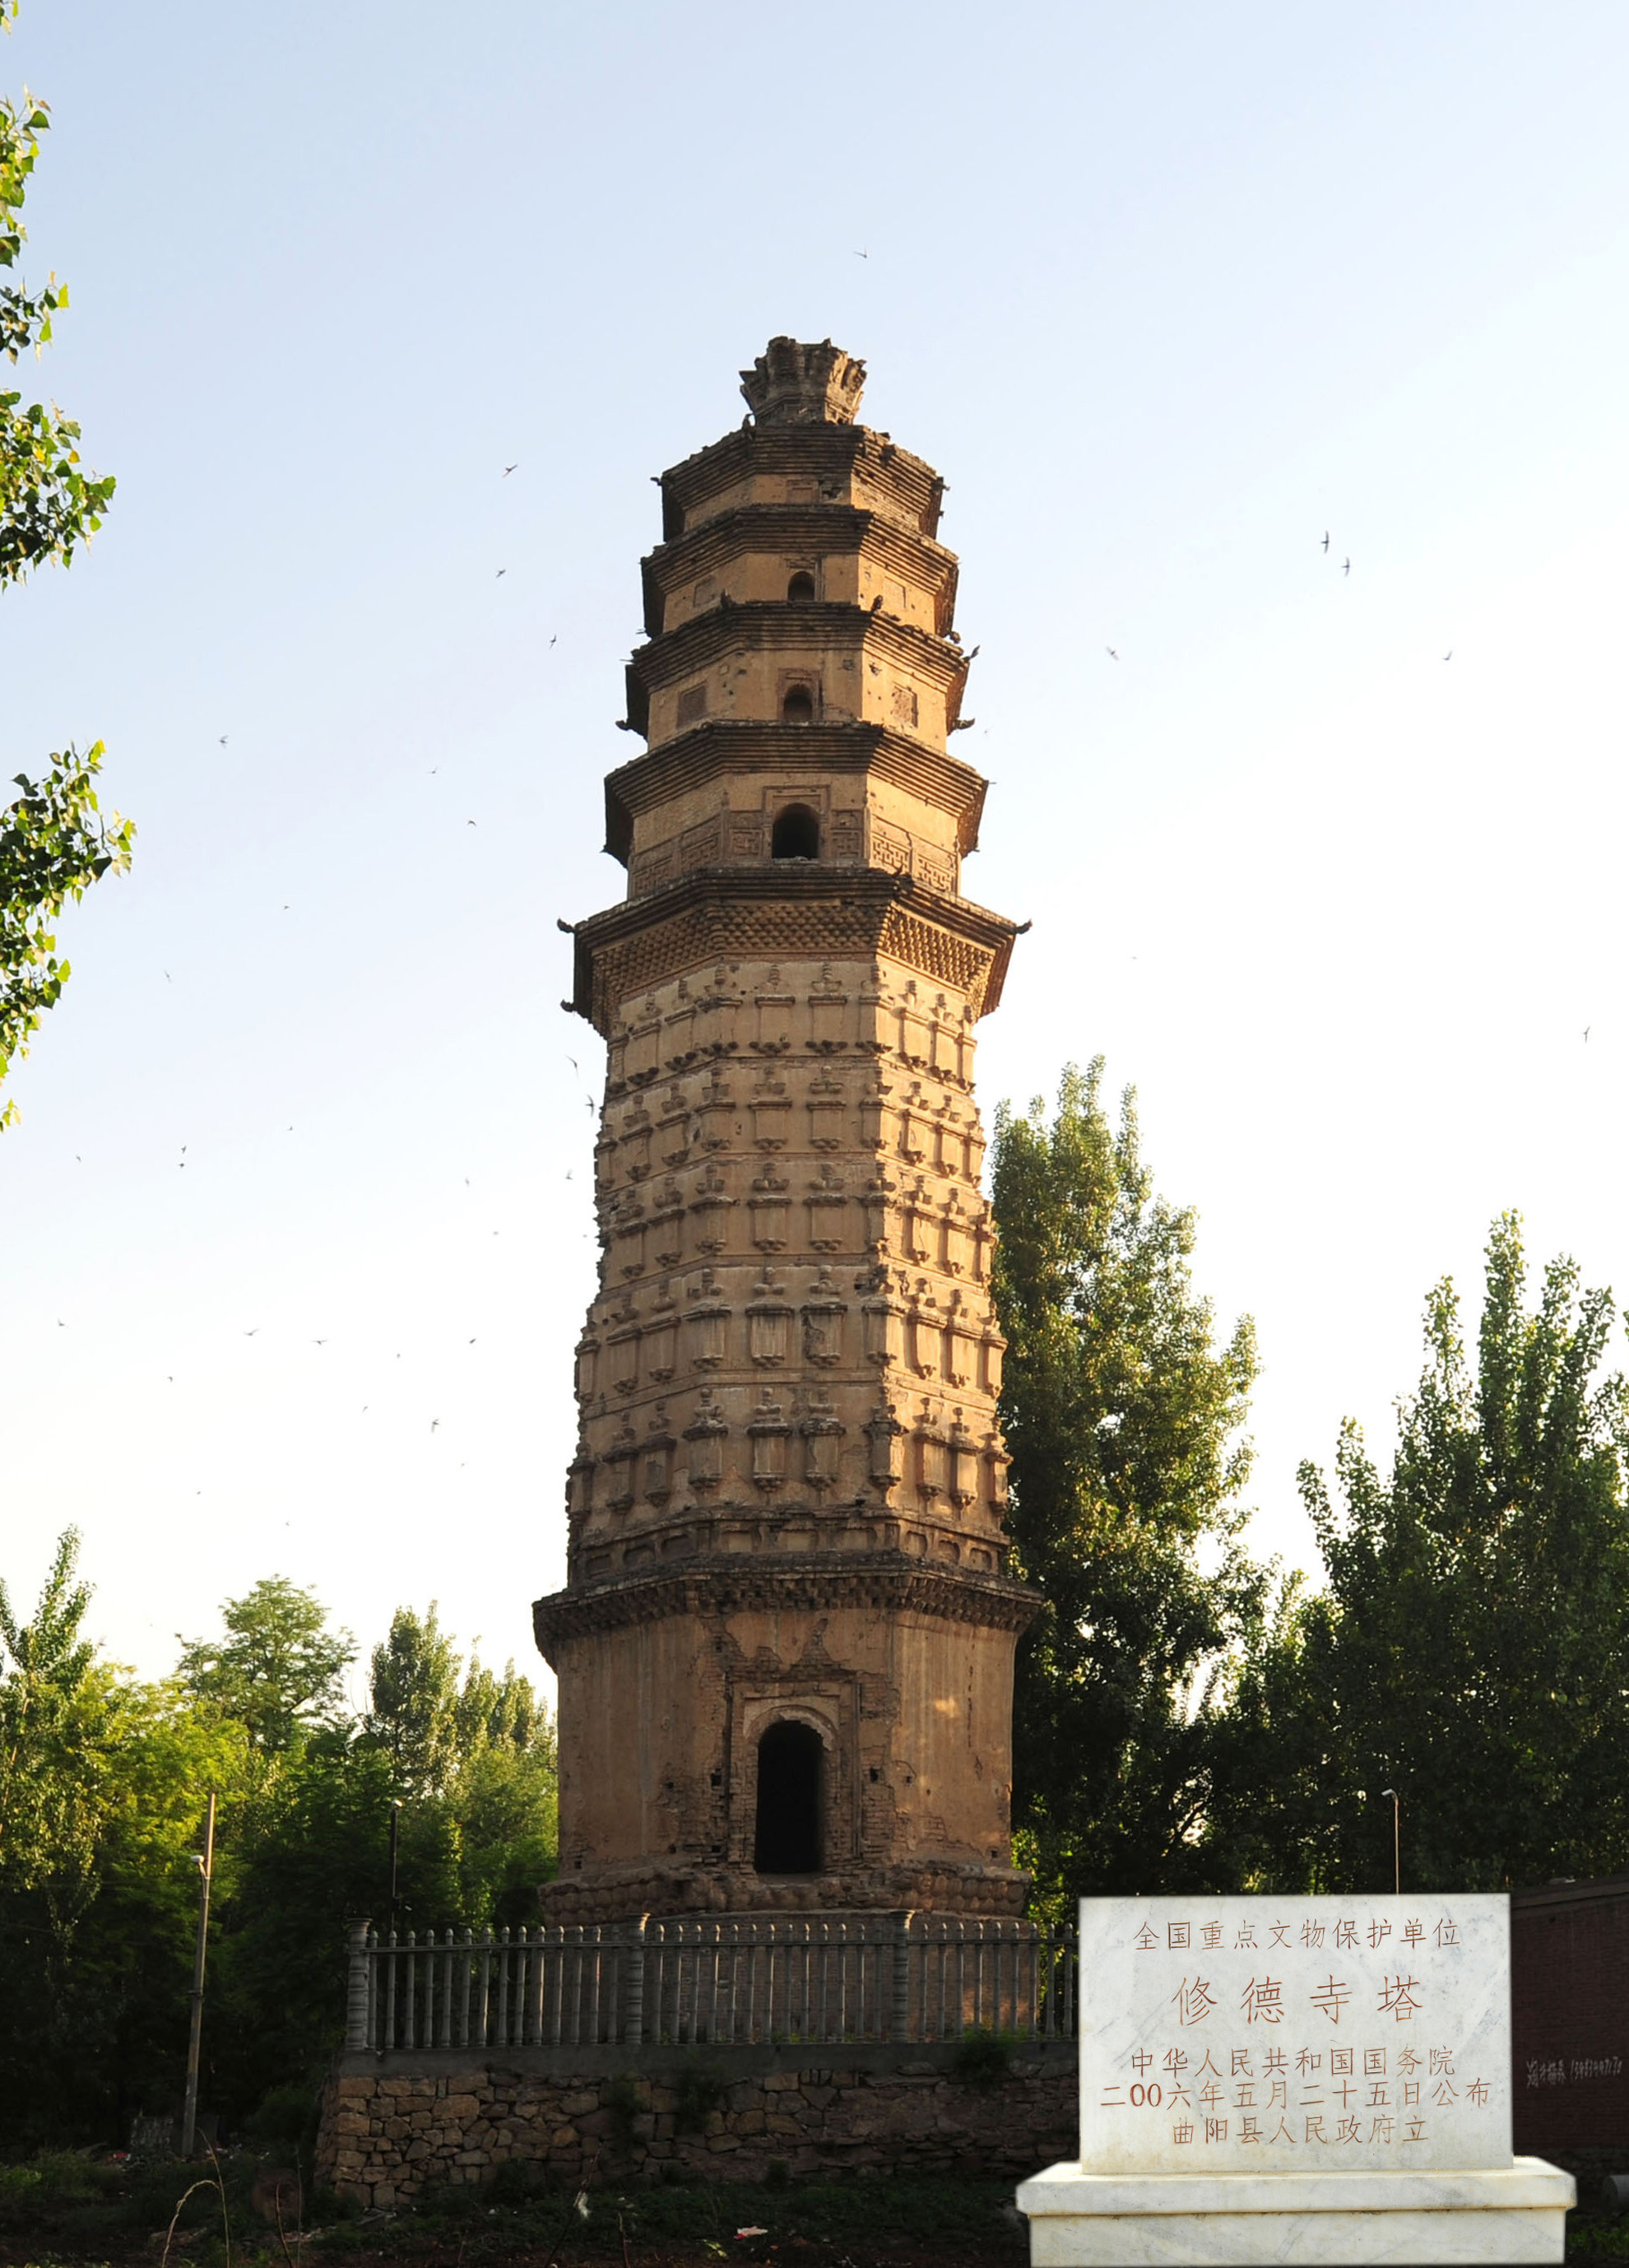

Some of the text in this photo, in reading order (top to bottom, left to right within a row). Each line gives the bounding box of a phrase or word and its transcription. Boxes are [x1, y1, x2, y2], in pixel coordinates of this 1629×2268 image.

[1133, 1918, 1461, 1951] 全国重点文物保护单位
[1172, 1974, 1423, 2026] 修德寺塔
[1131, 2046, 1455, 2079] 中华人民共和国国务院
[1172, 2114, 1429, 2145] 曲阳县人民政府立
